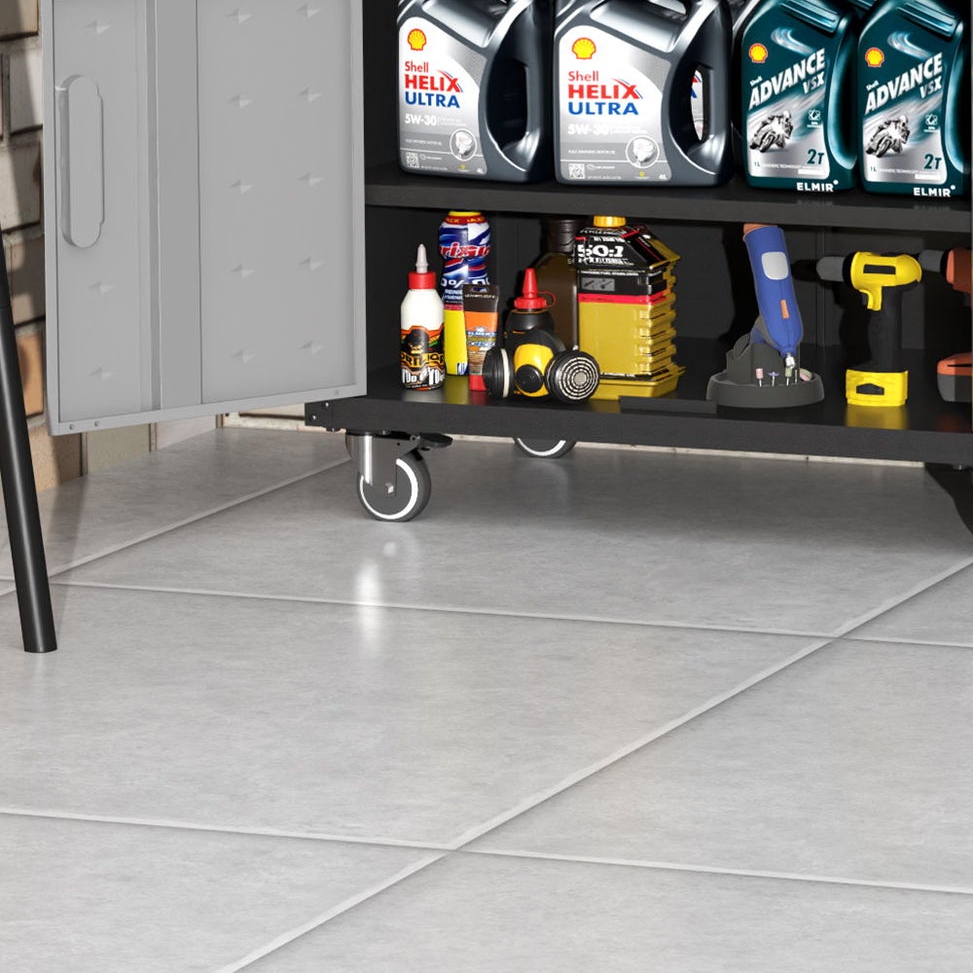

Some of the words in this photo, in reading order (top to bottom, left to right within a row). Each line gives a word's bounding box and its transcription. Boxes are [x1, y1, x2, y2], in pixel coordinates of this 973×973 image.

[404, 61, 429, 73] Shell
[404, 72, 463, 93] HELIX
[568, 71, 599, 82] Shell
[749, 48, 825, 111] ADVANCE
[803, 71, 825, 94] VSX
[865, 52, 943, 115] ADVANCE
[568, 82, 641, 99] HELIX
[920, 76, 942, 99] VSX
[405, 91, 460, 108] ULTRA
[568, 102, 639, 115] ULTRA
[405, 113, 437, 126] 5W-30
[807, 149, 824, 164] 2T
[924, 154, 942, 169] 2T
[796, 182, 834, 192] ELMIR
[913, 187, 951, 197] ELMIR
